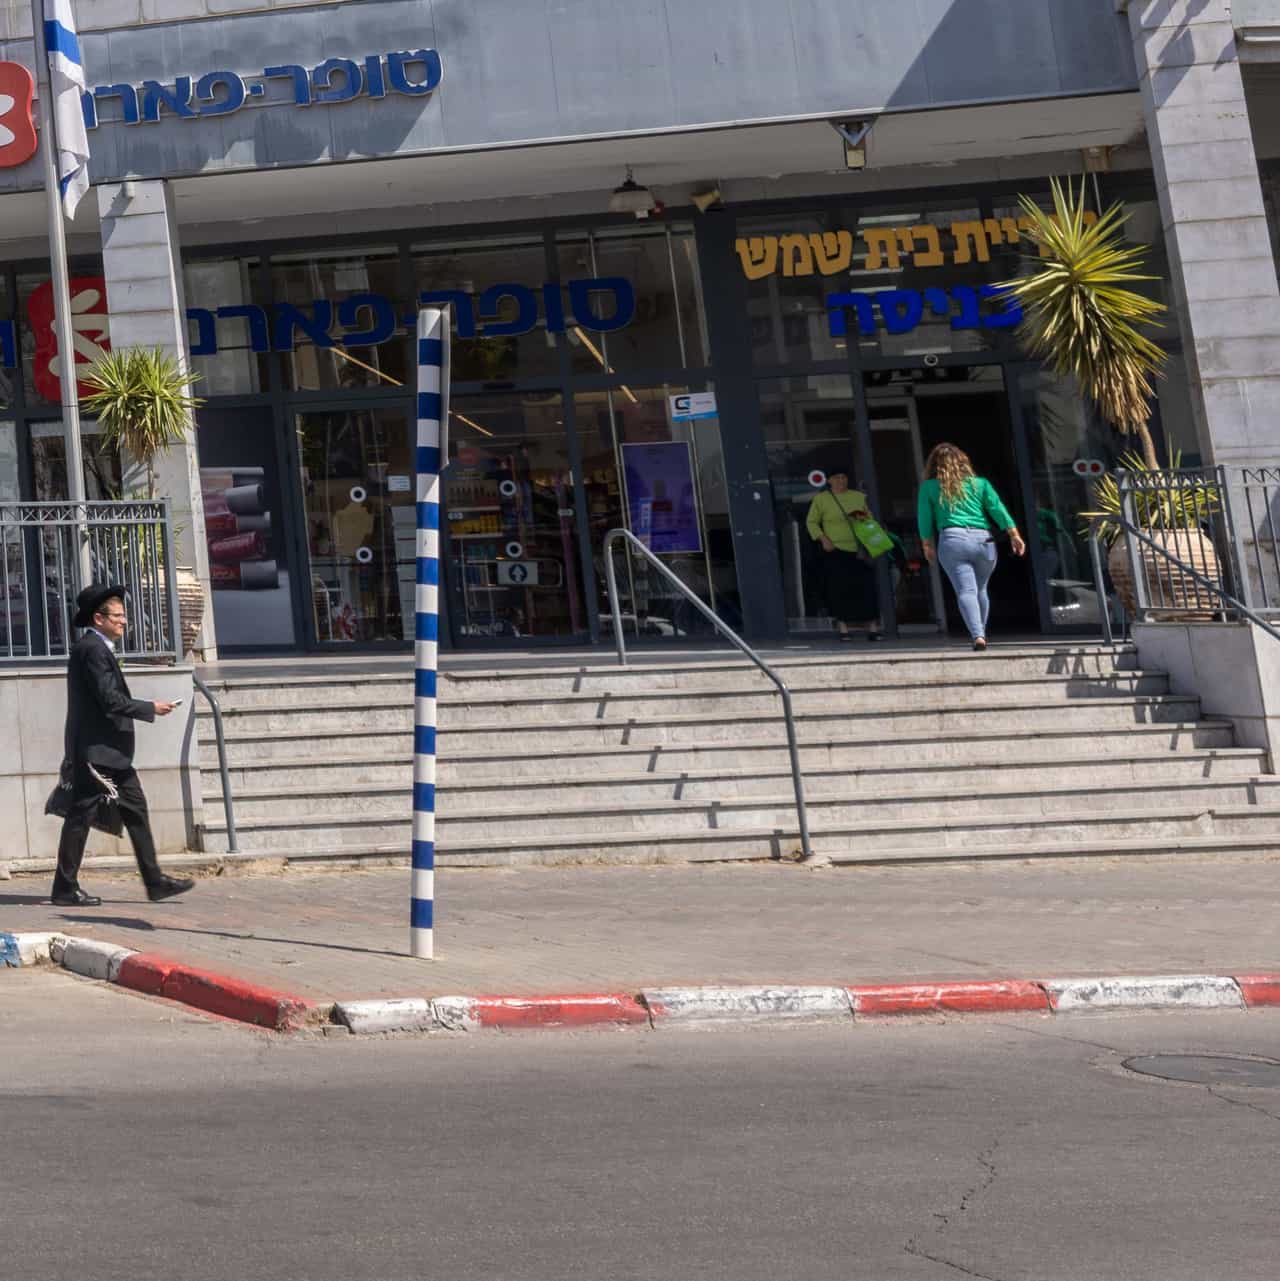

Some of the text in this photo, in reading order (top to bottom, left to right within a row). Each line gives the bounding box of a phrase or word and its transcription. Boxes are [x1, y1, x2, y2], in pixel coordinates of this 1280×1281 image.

[736, 230, 851, 280] שמש
[863, 225, 944, 269] בית
[827, 283, 1024, 337] כניסה
